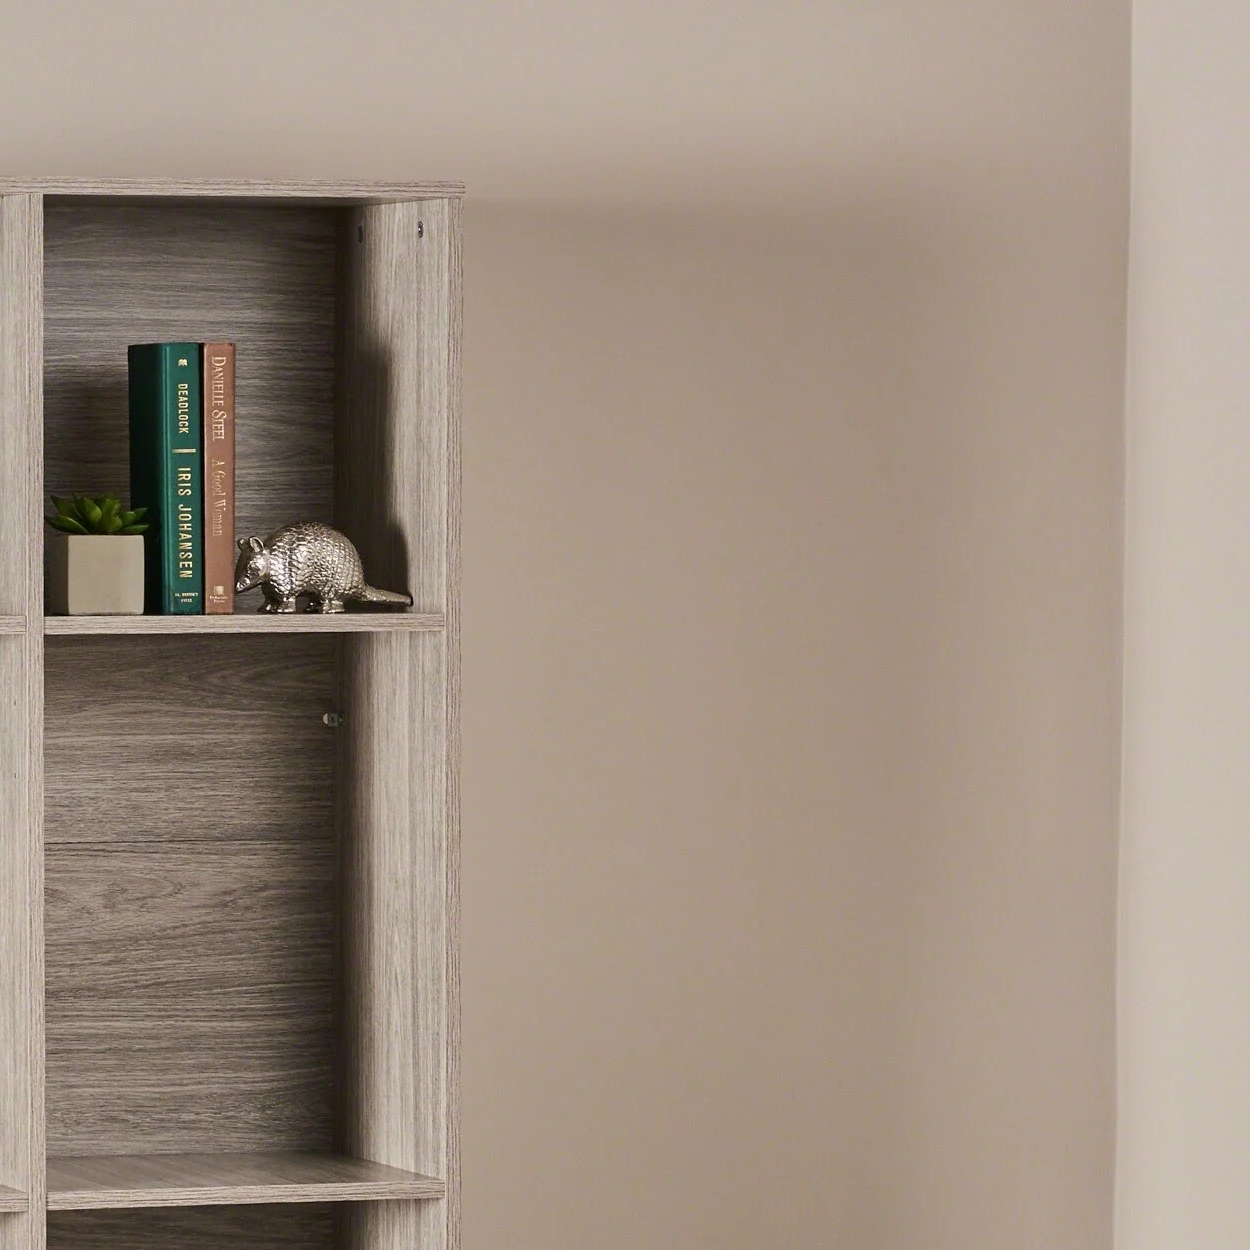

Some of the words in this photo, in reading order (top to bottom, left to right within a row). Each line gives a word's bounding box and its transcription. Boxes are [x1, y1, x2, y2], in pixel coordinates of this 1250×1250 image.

[212, 356, 226, 406] DANIELLE
[177, 383, 189, 434] DEADLOCK
[212, 410, 227, 441] STEEL
[177, 467, 192, 496] IRIS
[177, 504, 193, 578] JOHANSEN
